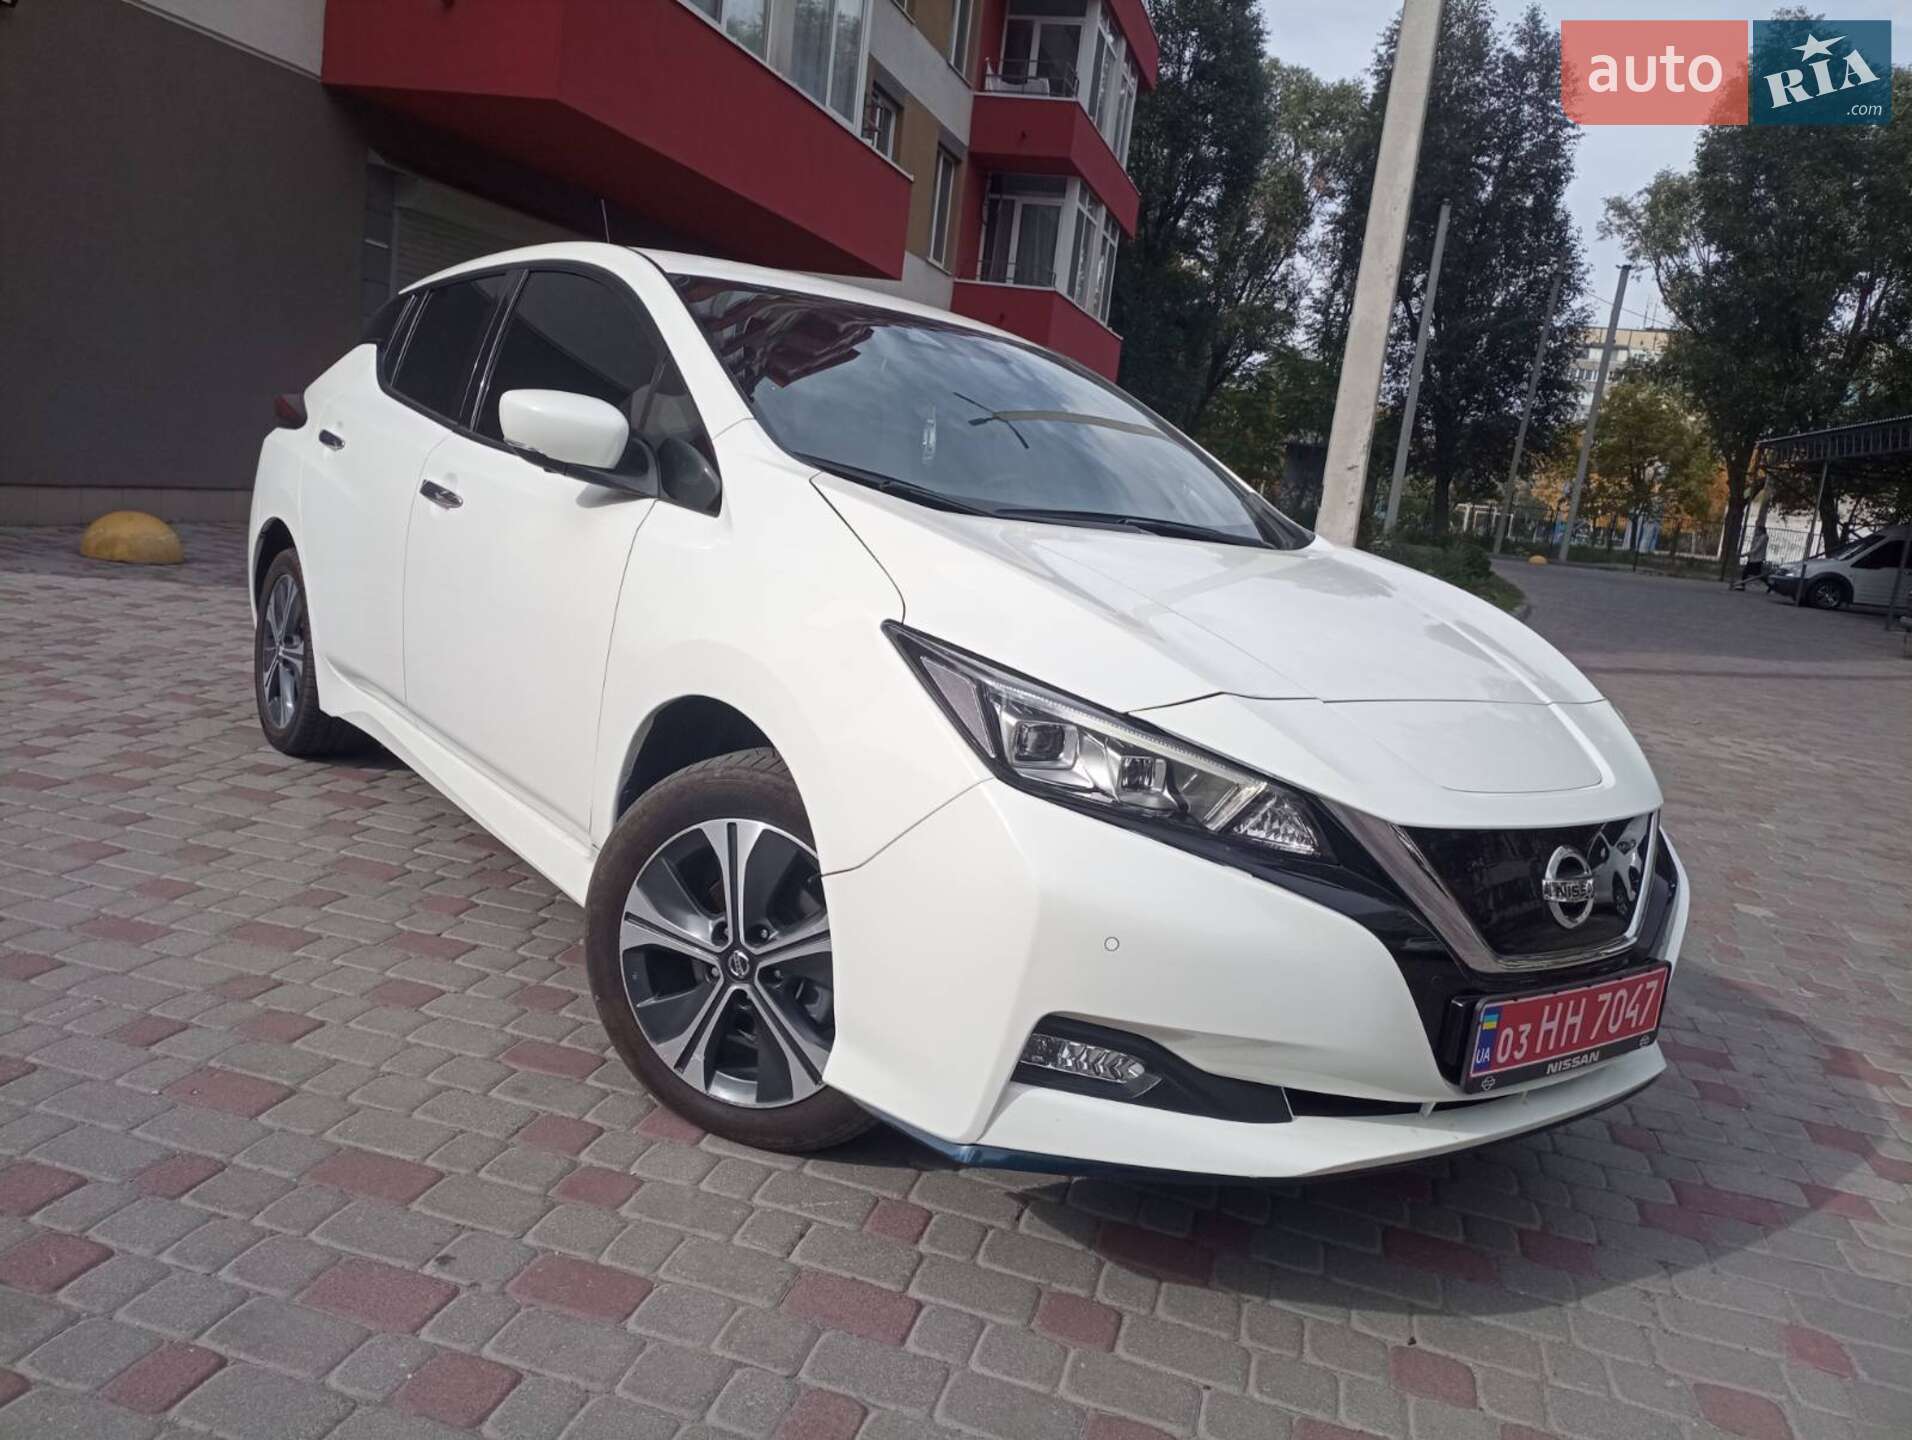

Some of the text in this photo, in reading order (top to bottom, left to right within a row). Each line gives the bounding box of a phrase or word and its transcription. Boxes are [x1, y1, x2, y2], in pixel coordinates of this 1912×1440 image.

[1496, 1023, 1531, 1064] 03
[1590, 980, 1658, 1041] 7047
[1475, 1049, 1491, 1065] UA
[1546, 1050, 1600, 1075] NISSAN
